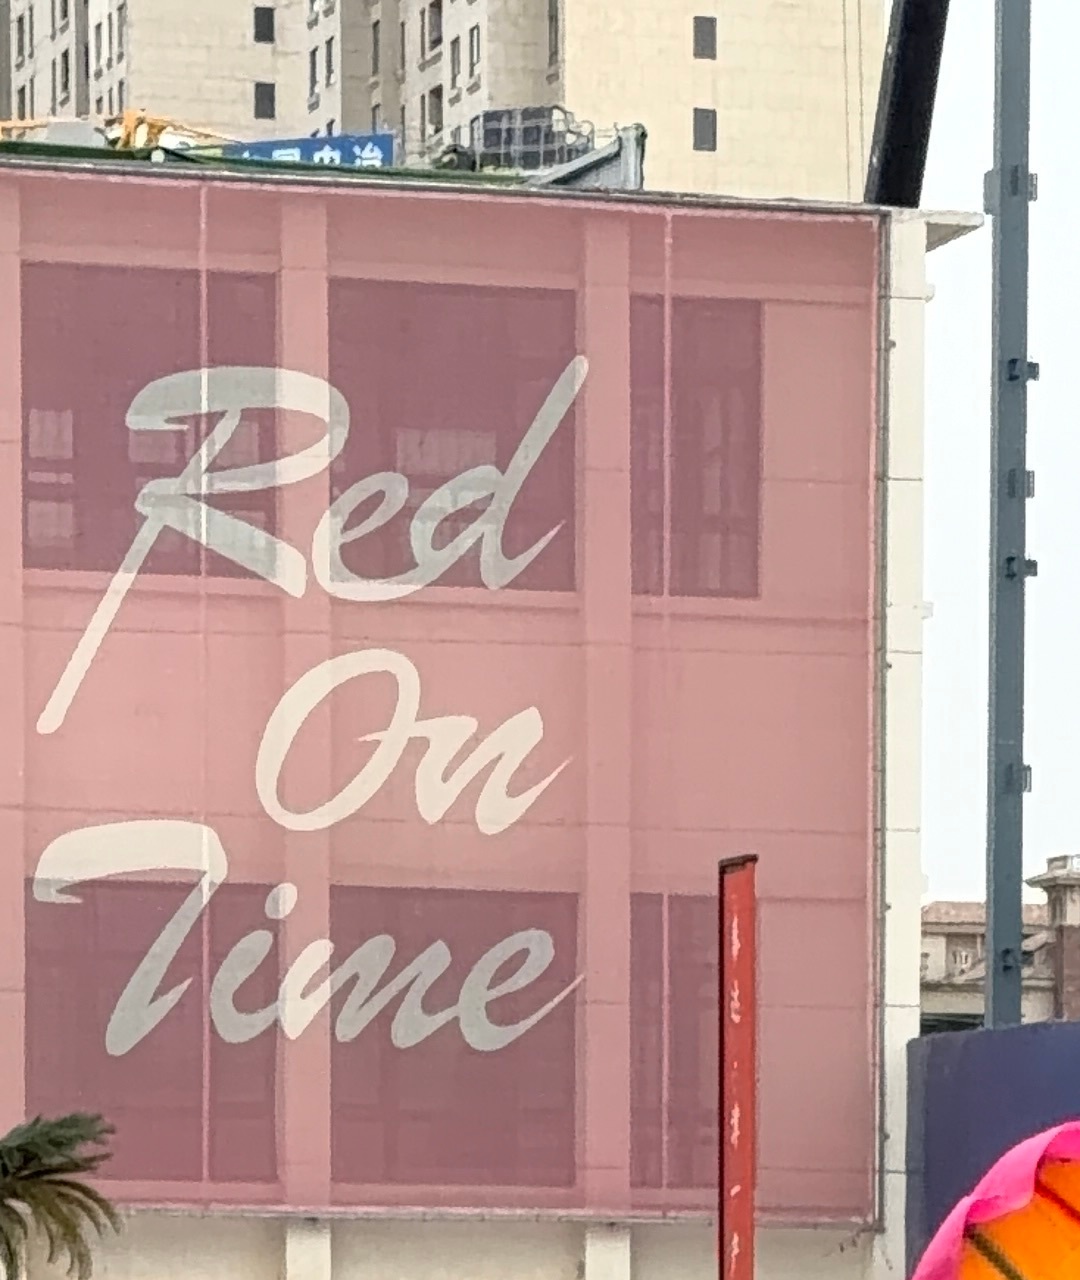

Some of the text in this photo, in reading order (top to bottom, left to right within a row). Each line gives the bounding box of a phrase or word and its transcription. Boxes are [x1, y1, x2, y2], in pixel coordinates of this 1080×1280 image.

[35, 355, 589, 734] Red
[255, 648, 572, 835] On
[33, 819, 585, 1057] Time
